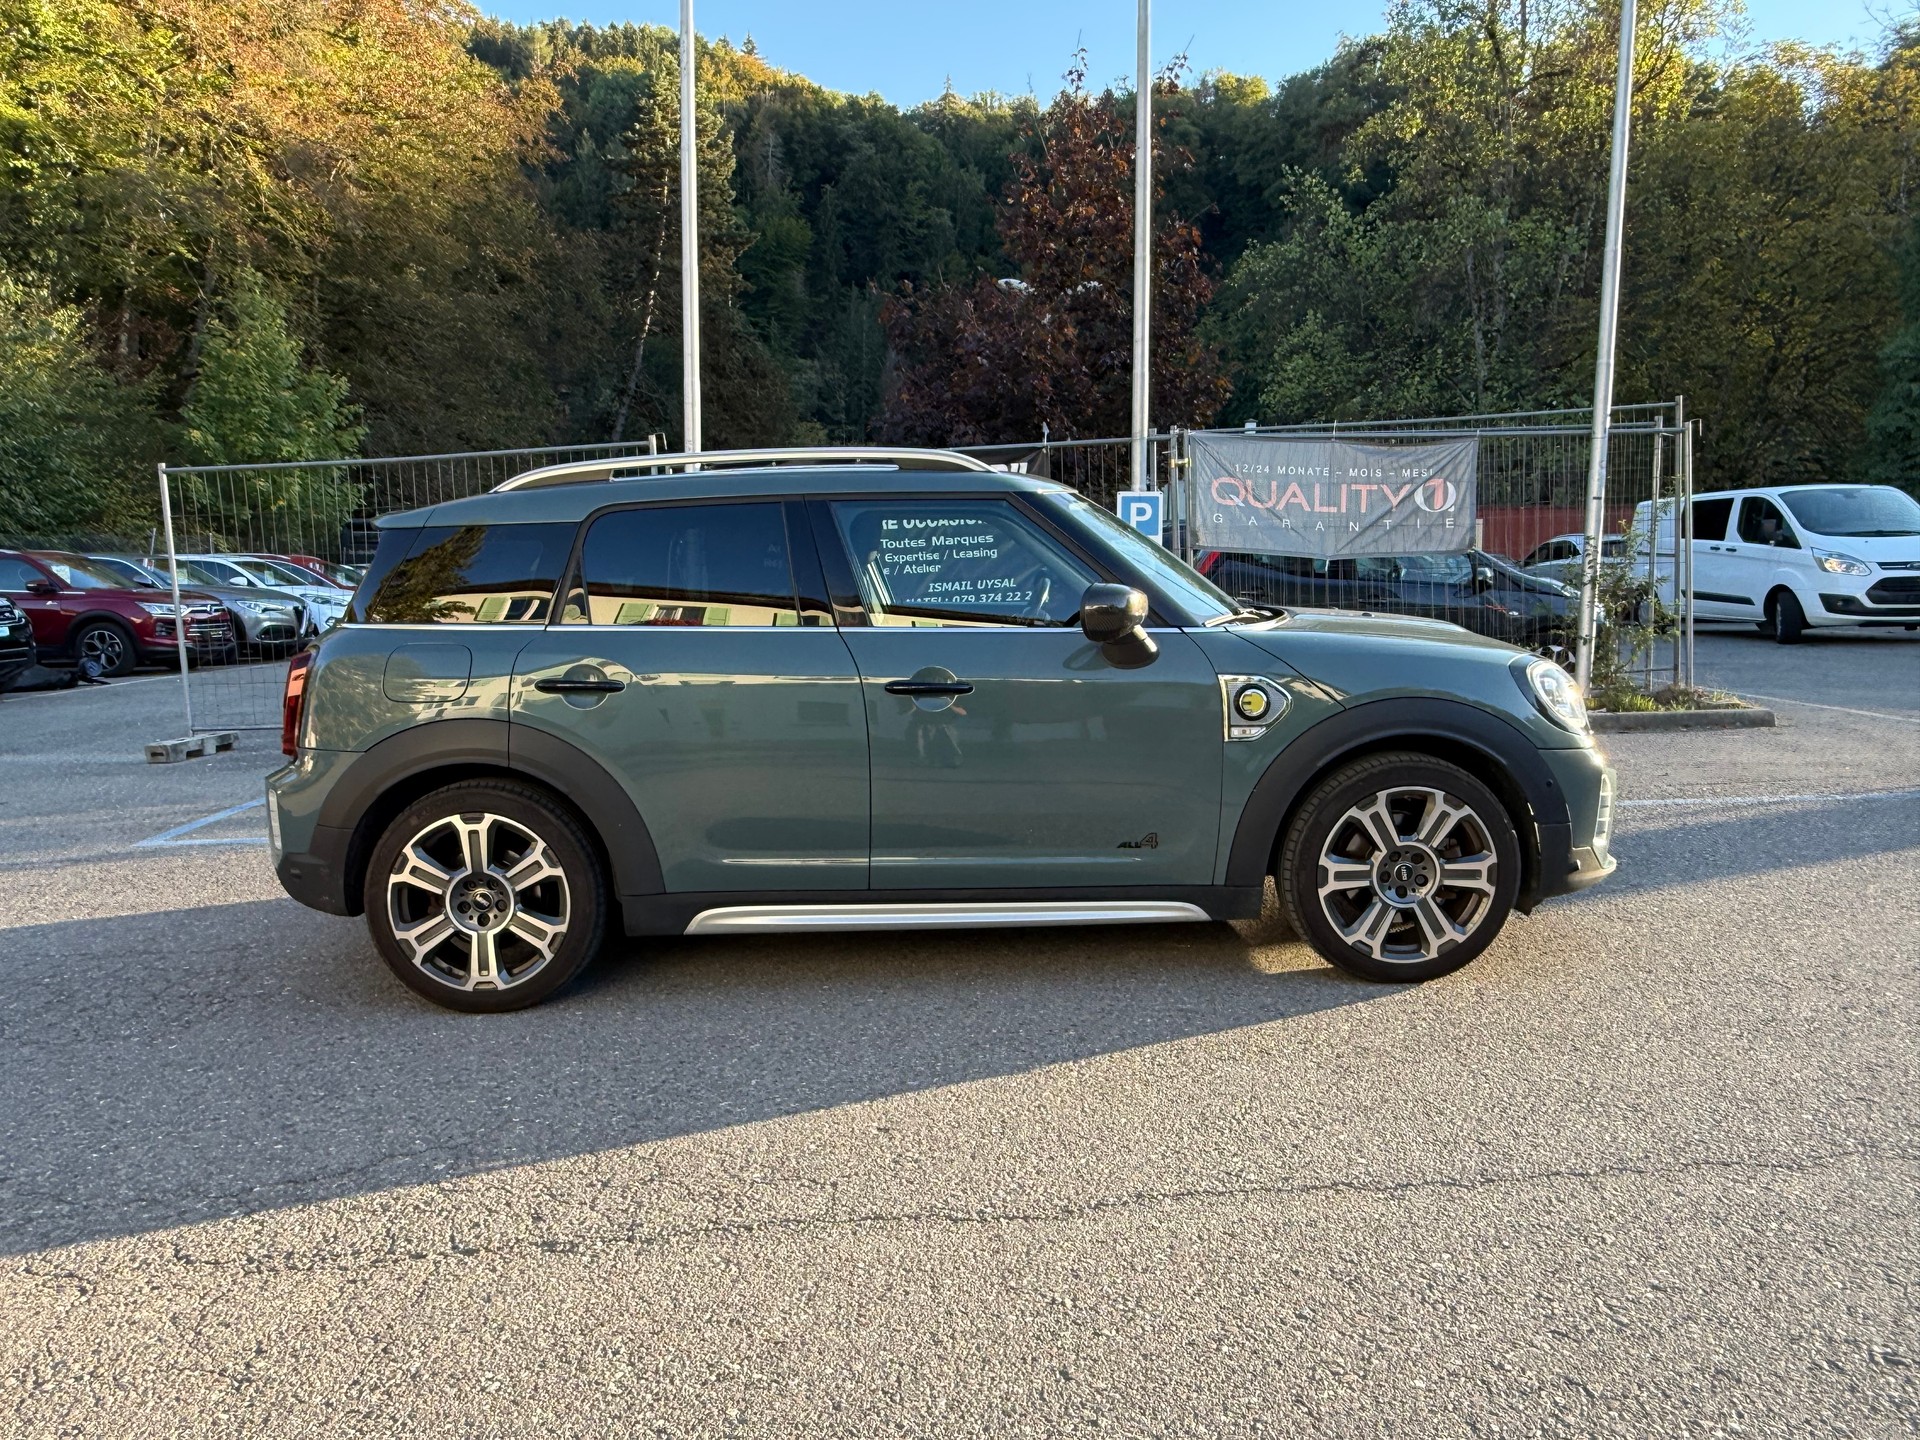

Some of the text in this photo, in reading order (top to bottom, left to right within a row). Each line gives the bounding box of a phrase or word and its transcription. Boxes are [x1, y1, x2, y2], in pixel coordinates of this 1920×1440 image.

[1235, 464, 1270, 474] 12/24
[1277, 465, 1330, 477] MONATE
[1349, 468, 1382, 477] MOIS
[1401, 468, 1433, 477] MESI
[1211, 476, 1412, 513] QUALITY
[1129, 502, 1153, 529] P
[1213, 513, 1455, 532] GARANTIE
[880, 534, 994, 549] Toutes Marques
[884, 551, 940, 564] Expertise
[953, 548, 998, 560] Leasing
[903, 563, 942, 575] Atelier
[928, 578, 1017, 592] ISMAIL UYSAL
[952, 594, 975, 603] 079
[980, 592, 1002, 602] 374
[1006, 591, 1021, 601] 22
